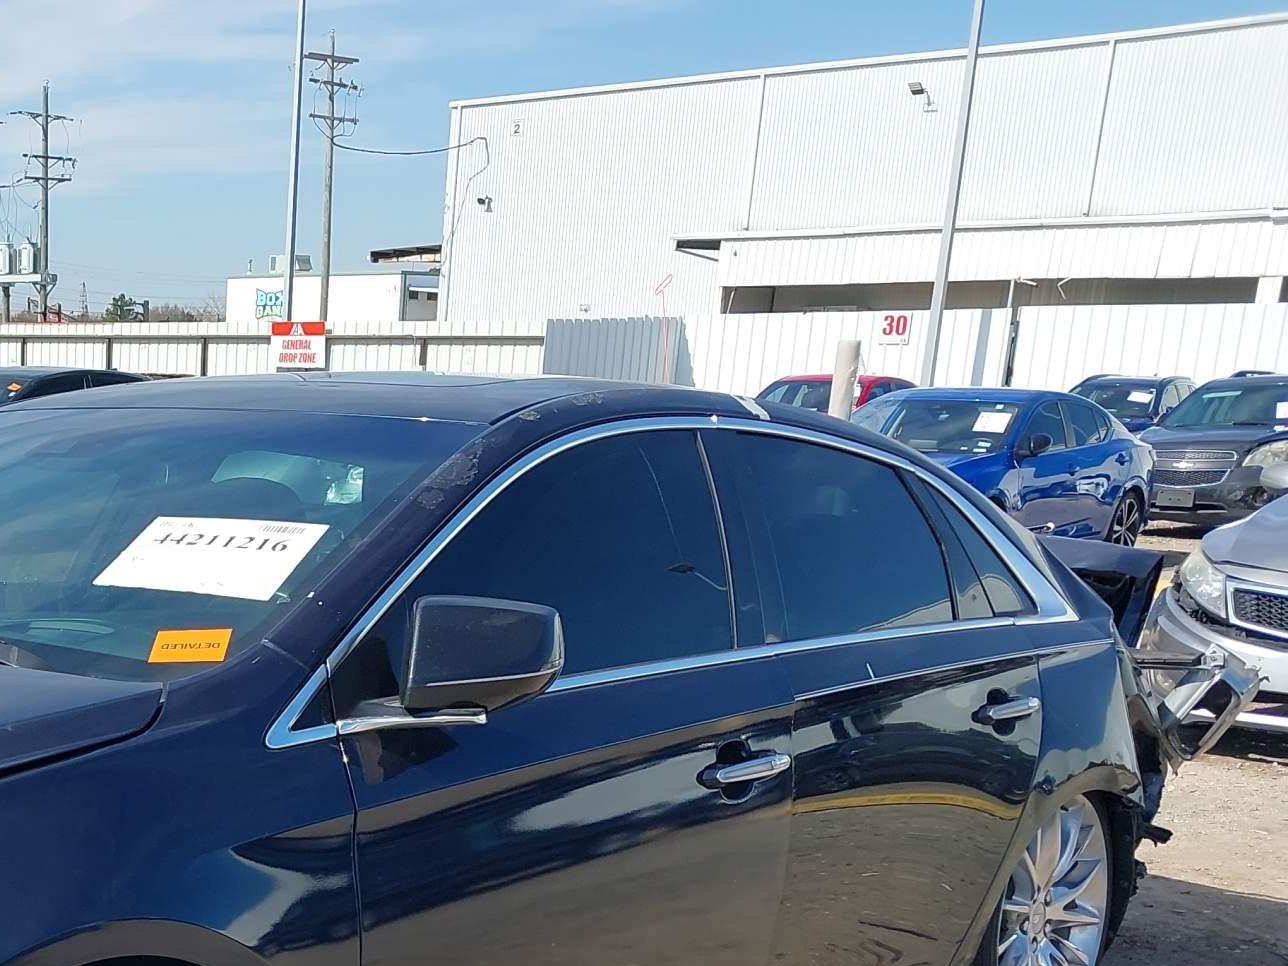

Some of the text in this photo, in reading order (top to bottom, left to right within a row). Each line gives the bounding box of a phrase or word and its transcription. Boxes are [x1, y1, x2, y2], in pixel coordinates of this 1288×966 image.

[513, 123, 521, 134] 2
[882, 315, 908, 336] 30
[282, 339, 312, 350] GENERAL
[278, 352, 317, 363] DROP ZONE
[153, 532, 290, 553] 44211216
[161, 642, 221, 650] DETAILED
